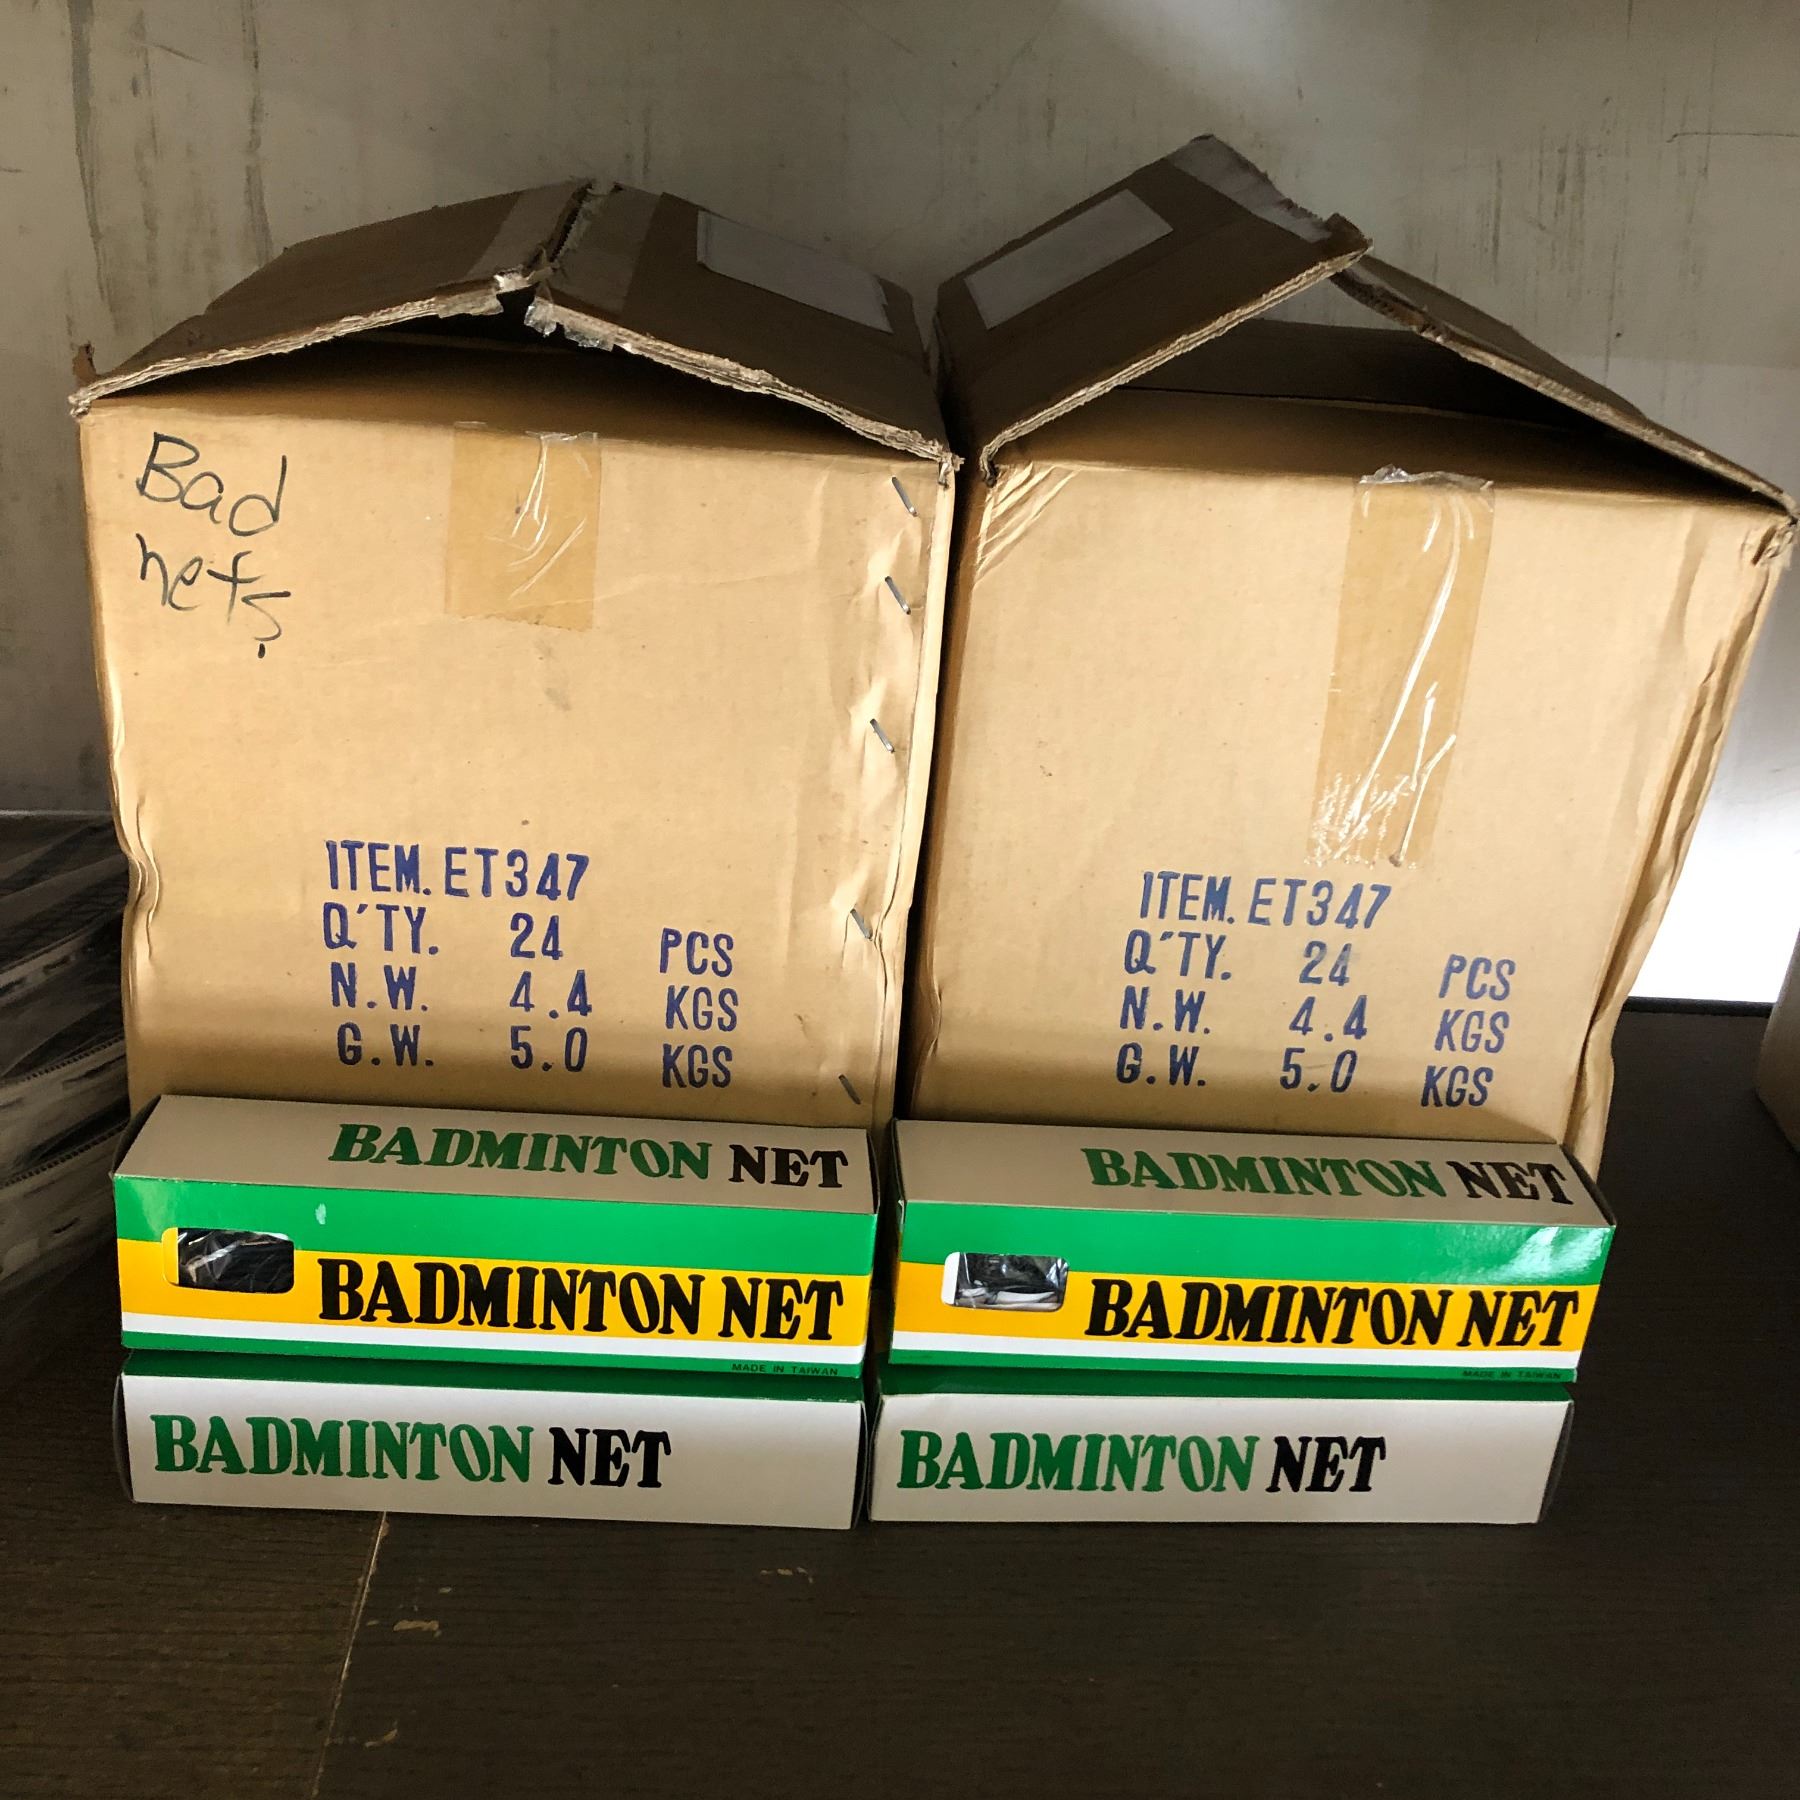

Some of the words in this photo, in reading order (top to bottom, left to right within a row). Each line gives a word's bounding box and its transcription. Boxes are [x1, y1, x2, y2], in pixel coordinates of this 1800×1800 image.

[136, 431, 288, 537] Bad
[325, 840, 431, 896] ITEM.
[445, 846, 590, 901] ET347
[1139, 870, 1236, 925] ITEM.
[1248, 877, 1392, 930] ET347
[510, 912, 564, 960] 24
[660, 927, 734, 978] PCS
[1300, 940, 1353, 987] 24
[1438, 953, 1517, 1001] PCS
[509, 969, 593, 1019] 4.4
[665, 985, 739, 1032] KGS
[1289, 994, 1369, 1043] 4.4
[1434, 1008, 1511, 1055] KGS
[510, 1025, 589, 1073] 5.0
[661, 1043, 733, 1089] KGS
[1279, 1046, 1359, 1093] 5.0
[1420, 1064, 1494, 1108] KGS
[327, 1122, 713, 1181] BADMINTON
[728, 1143, 849, 1189] NET
[1080, 1147, 1447, 1200] BADMINTON
[1446, 1160, 1575, 1206] NET
[317, 1258, 705, 1336] BADMINTON
[718, 1275, 845, 1342] NET
[1083, 1278, 1455, 1347] BADMINTON
[1459, 1289, 1581, 1348] NET
[731, 1363, 767, 1373] MADE
[773, 1365, 785, 1374] IN
[791, 1366, 838, 1376] TAIWAN
[150, 1414, 535, 1483] BADMINTON
[547, 1427, 672, 1489] NET
[897, 1429, 1260, 1493] BADMINTON
[1265, 1435, 1387, 1493] NET
